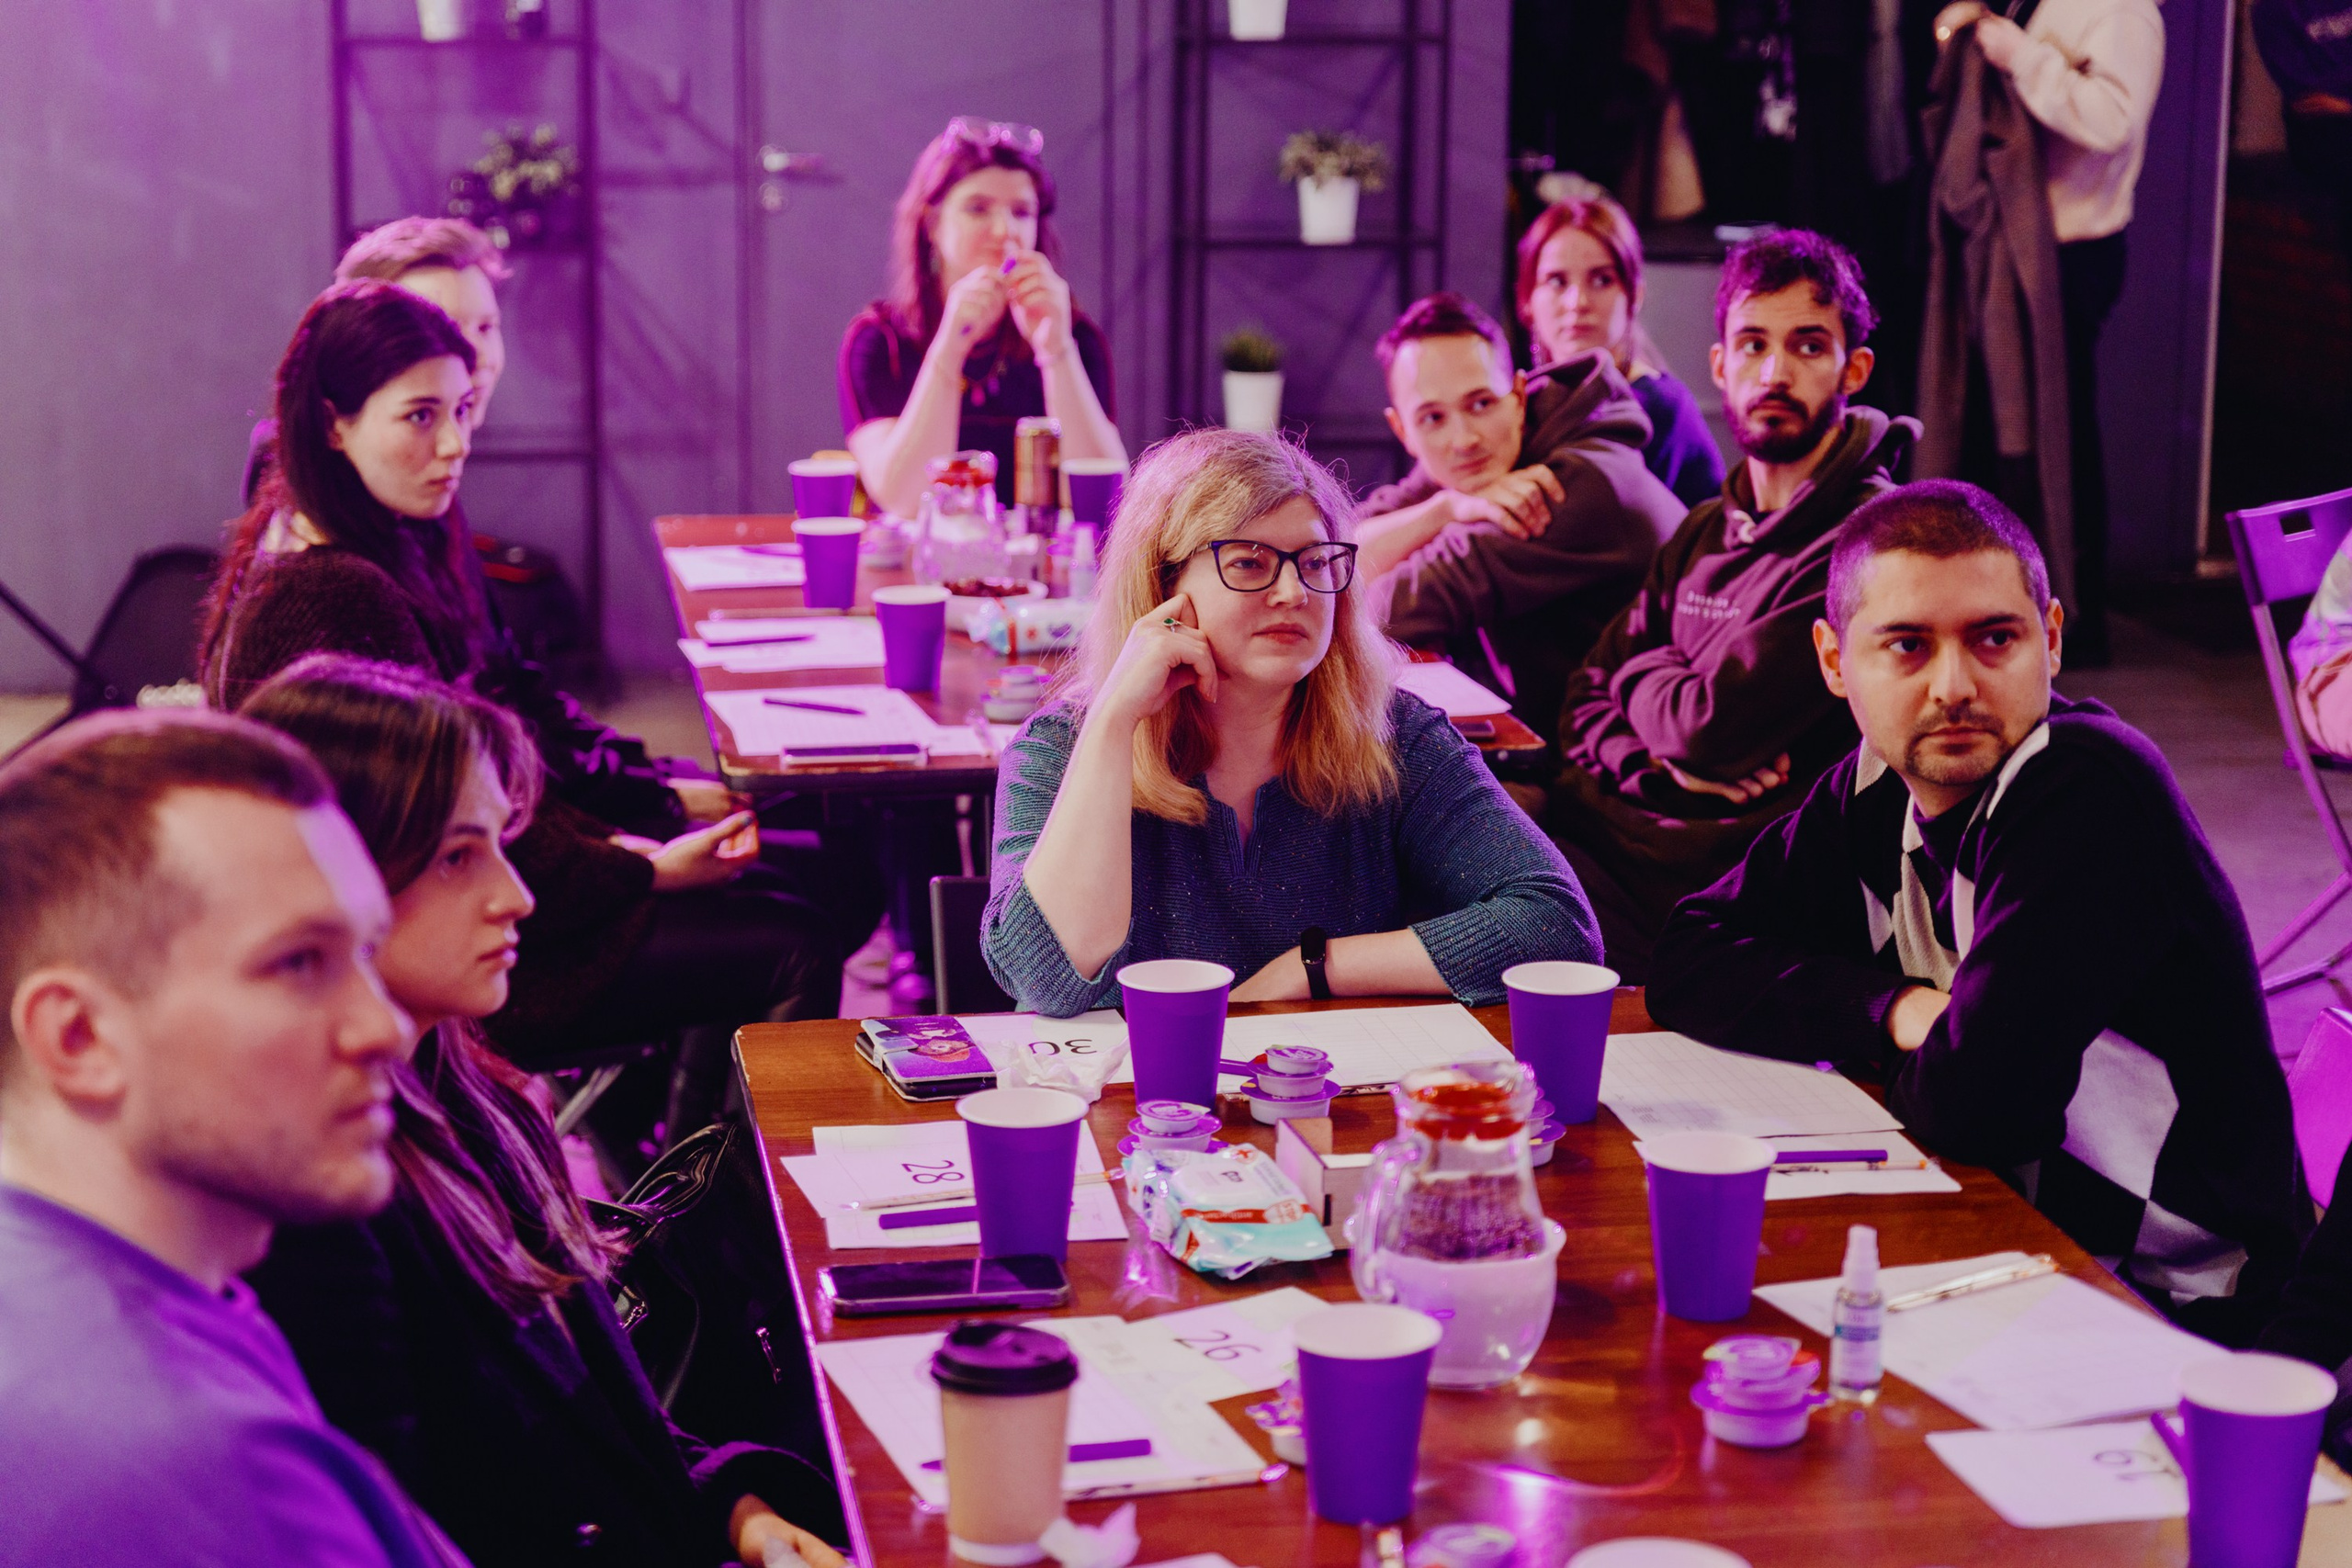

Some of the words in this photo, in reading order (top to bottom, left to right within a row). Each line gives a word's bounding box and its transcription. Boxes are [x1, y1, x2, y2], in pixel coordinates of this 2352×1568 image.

[1027, 1038, 1098, 1056] 30
[900, 1158, 966, 1185] 28
[1172, 1328, 1262, 1361] 26
